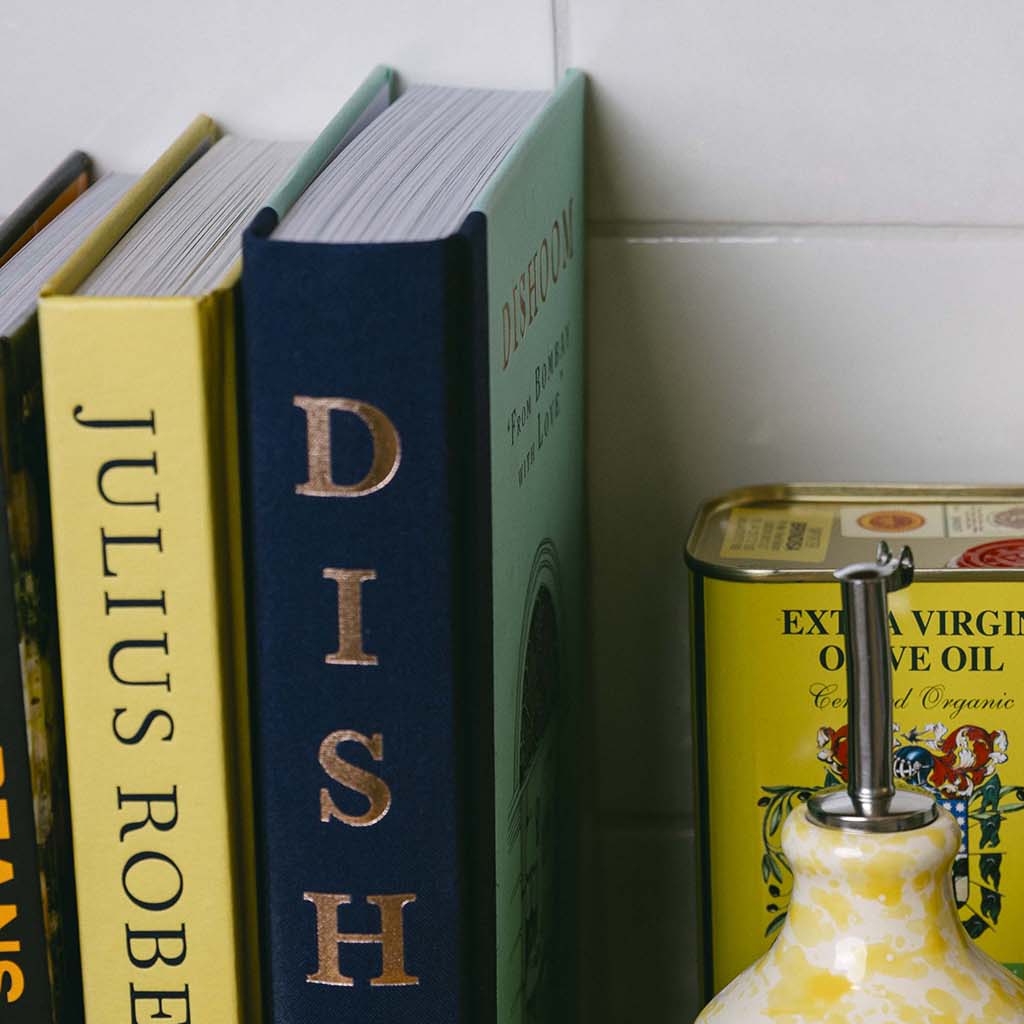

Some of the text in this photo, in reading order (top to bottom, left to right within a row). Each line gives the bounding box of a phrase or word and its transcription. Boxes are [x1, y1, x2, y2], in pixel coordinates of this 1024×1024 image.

[502, 197, 574, 371] DISHOOM
[73, 404, 175, 746] JULIUS
[781, 609, 903, 636] EXTA
[818, 644, 1005, 672] OVE OIL
[919, 683, 1016, 720] Organic
